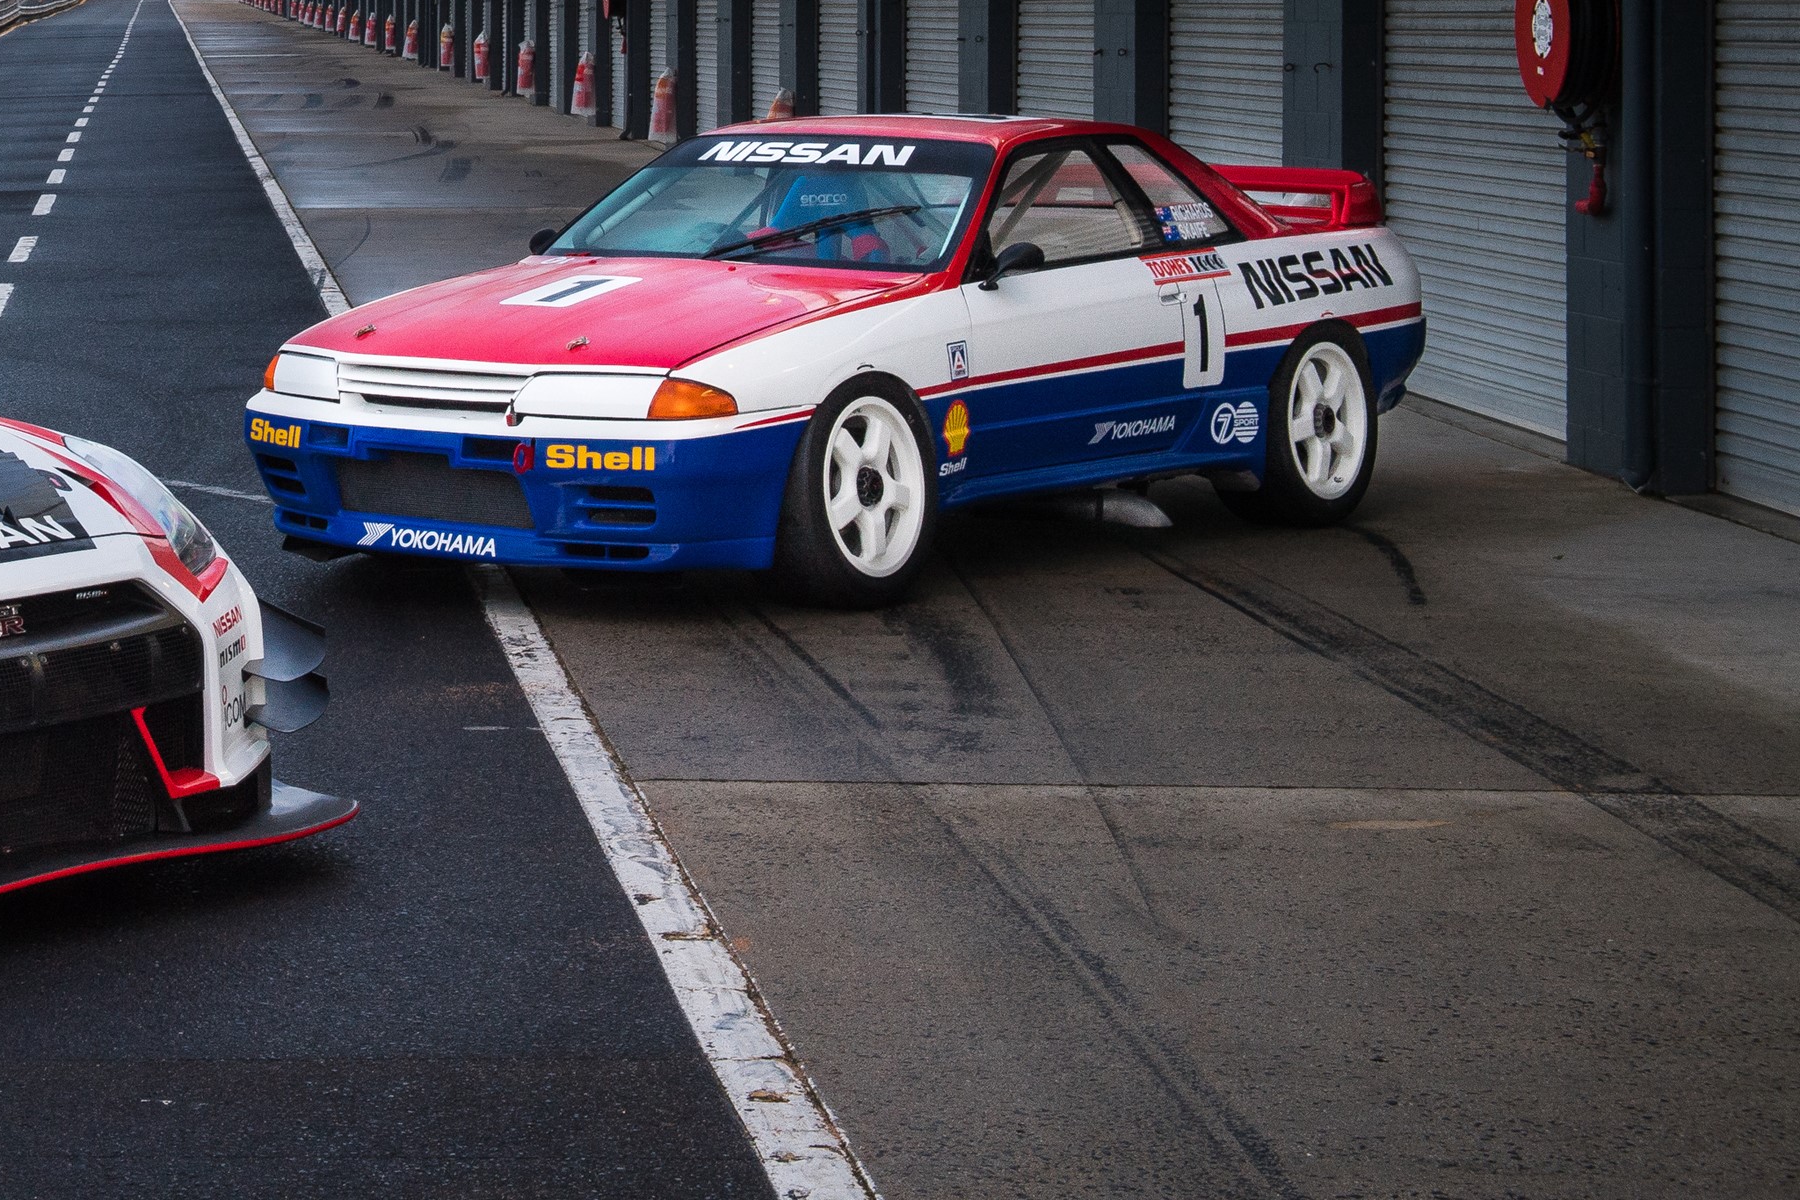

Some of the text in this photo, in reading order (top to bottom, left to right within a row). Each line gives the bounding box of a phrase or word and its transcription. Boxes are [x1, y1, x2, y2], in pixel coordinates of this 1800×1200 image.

[698, 141, 916, 166] NISSAN
[800, 191, 848, 206] sparco
[1169, 202, 1214, 221] RICHARDS
[1177, 221, 1211, 240] SKAIFE
[1237, 243, 1394, 310] NISSAN
[535, 278, 615, 303] 1
[1193, 293, 1209, 373] 1
[250, 418, 302, 449] Shell
[1111, 415, 1176, 440] YOKOHAMA
[1233, 418, 1259, 427] SPORT
[546, 444, 655, 471] Shell
[939, 457, 967, 477] Shell
[391, 528, 496, 557] YOKOHAMA
[212, 604, 242, 638] NISSAN
[220, 634, 246, 668] nismo
